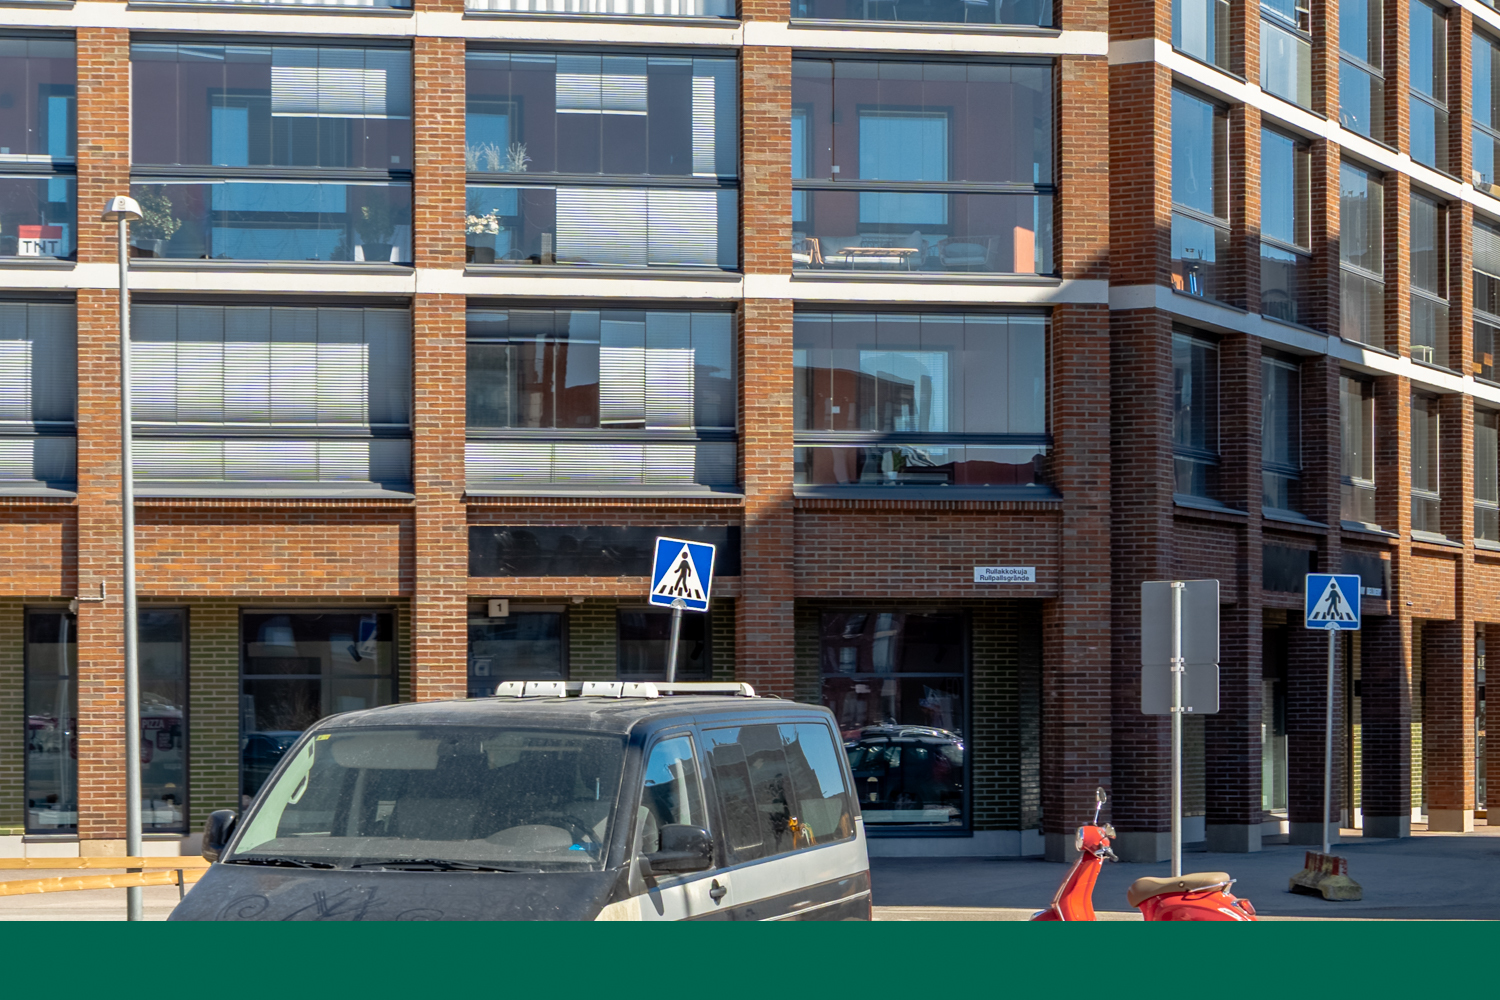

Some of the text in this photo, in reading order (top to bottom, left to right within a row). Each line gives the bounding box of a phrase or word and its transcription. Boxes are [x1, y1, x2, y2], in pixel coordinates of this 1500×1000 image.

[23, 240, 58, 254] TNT
[496, 603, 502, 612] 1
[142, 719, 165, 728] PIZZA
